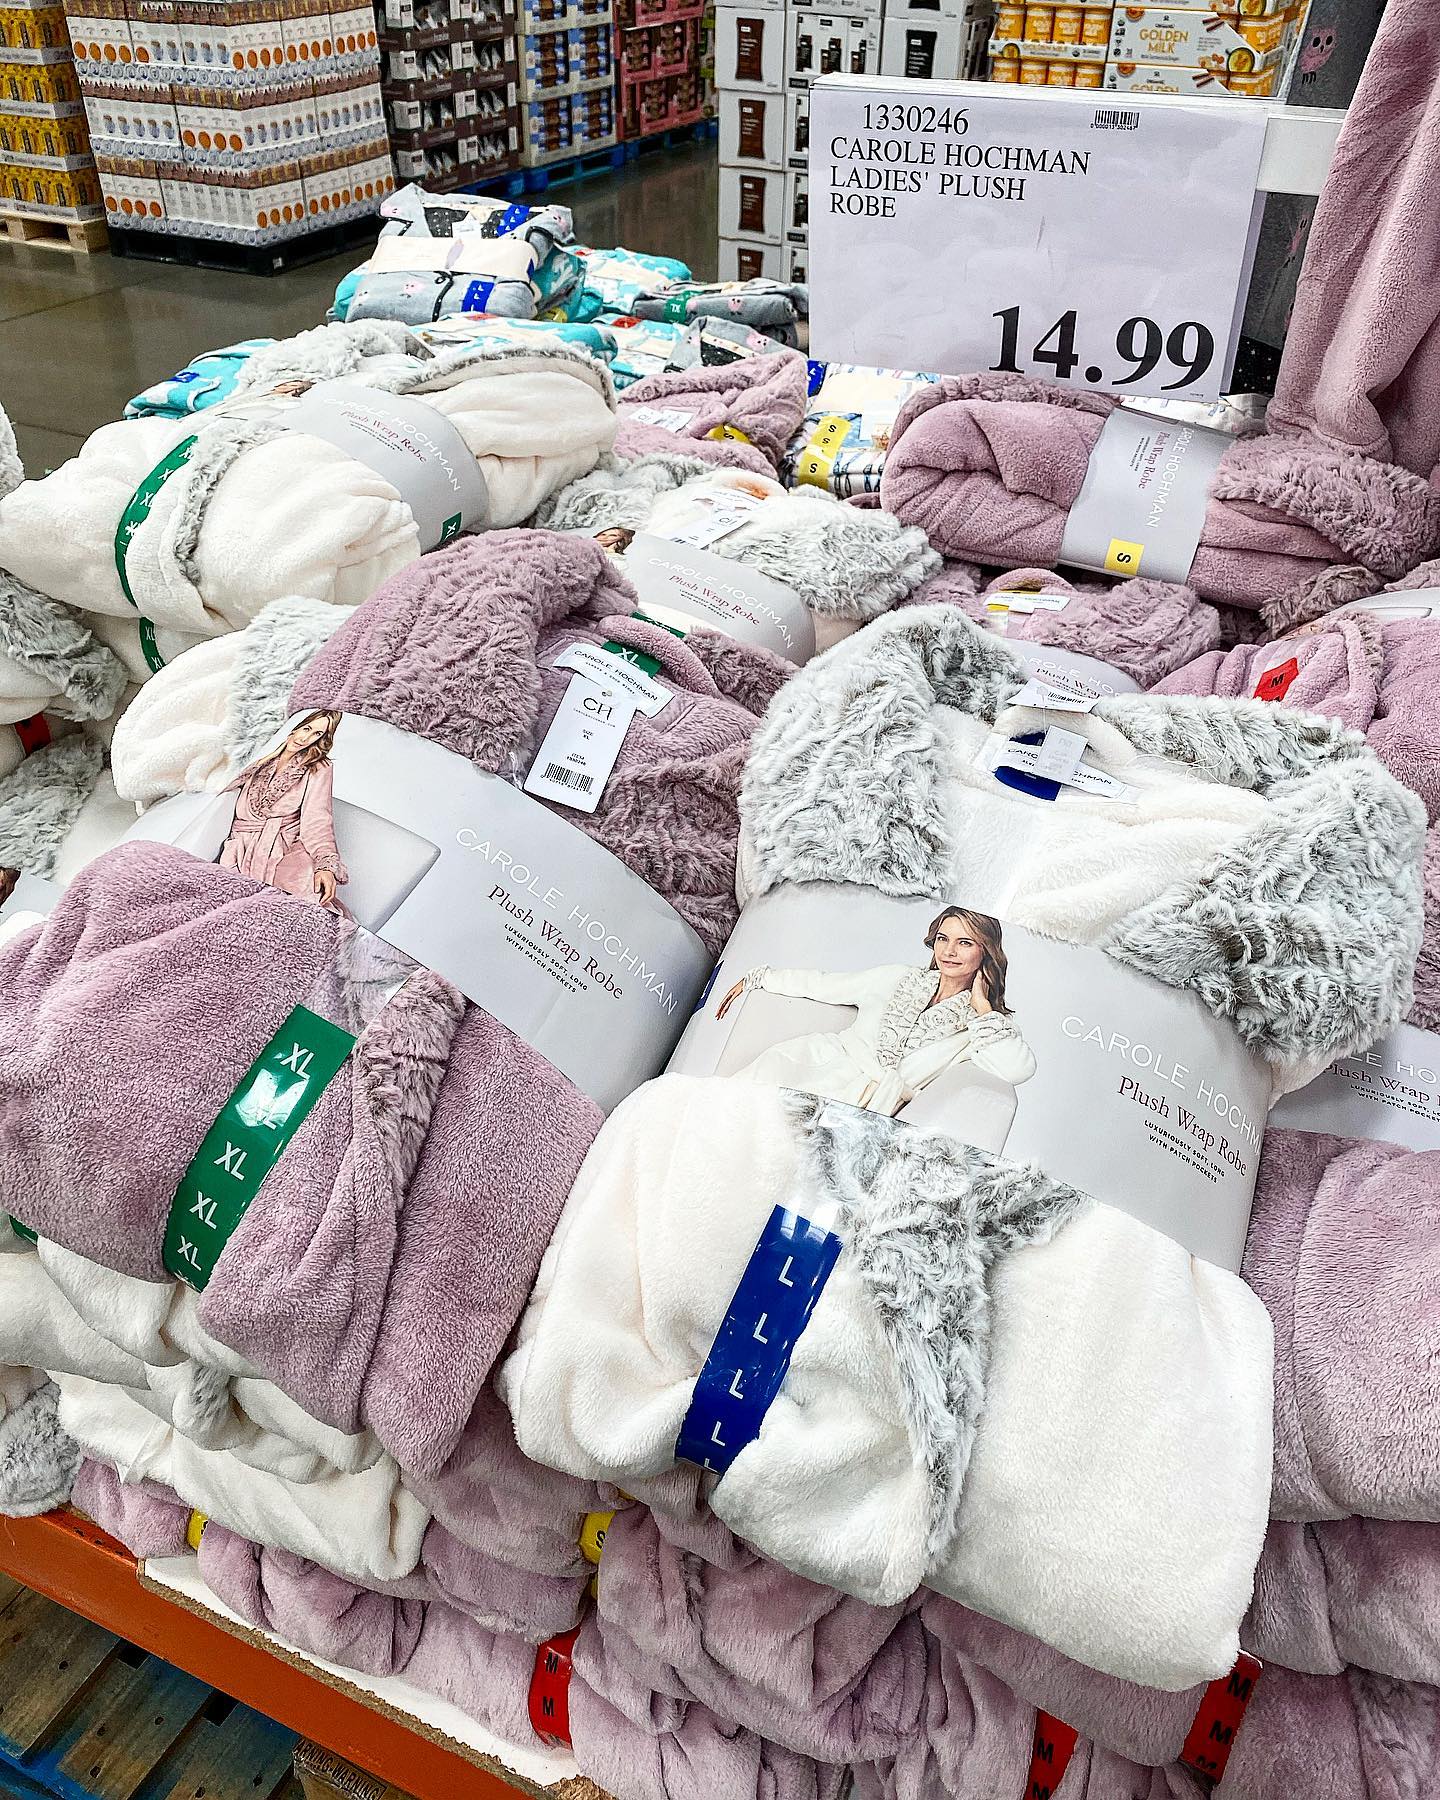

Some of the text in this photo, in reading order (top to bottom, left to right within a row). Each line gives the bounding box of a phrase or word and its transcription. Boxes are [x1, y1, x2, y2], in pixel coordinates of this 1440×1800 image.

[1140, 28, 1188, 42] GOLDEN
[1147, 41, 1175, 53] MILK
[863, 103, 969, 135] 1330246
[830, 137, 1091, 175] CAROLE HOCHMAN
[830, 166, 1027, 201] LADIES' PLUSH
[829, 193, 897, 218] ROBE
[988, 305, 1215, 391] 14.99
[373, 420, 399, 440] Wrap
[400, 438, 427, 463] Robe
[828, 424, 837, 433] S
[392, 415, 461, 491] HOCHMAN
[810, 463, 818, 474] S
[1145, 447, 1164, 465] Wrap
[1139, 467, 1156, 489] Robe
[1145, 454, 1182, 528] HOCHMAN
[1116, 552, 1131, 564] S
[647, 557, 794, 649] CAROLE HOCHMAN
[668, 574, 760, 626] Plush Wrap Robe
[614, 647, 640, 669] XL
[574, 650, 613, 669] CAROLE
[614, 669, 658, 701] HOCHMAN
[1270, 672, 1285, 689] M
[583, 697, 613, 721] CH
[1008, 748, 1039, 759] CARO
[1073, 770, 1112, 785] CHMAN
[455, 827, 678, 1016] CAROLE HOCHMAN
[487, 884, 623, 1000] Plush Wrap Robe
[504, 923, 588, 991] LUXURIOUSLY SOFT, LONG
[506, 935, 577, 993] WITH PATCH POCKETS
[280, 1042, 315, 1080] XL
[1060, 1014, 1191, 1091] CAROLE
[1350, 1084, 1404, 1103] LUXURIOUSLY
[1380, 1075, 1430, 1104] Wrap
[1358, 1092, 1440, 1122] WITH PATCH POCKET
[1117, 1075, 1247, 1176] Plush Wrap Robe
[213, 1141, 246, 1181] XL
[1144, 1119, 1225, 1177] LUXURIOUSLY SOFT, LONG
[1149, 1134, 1218, 1183] WITH PATCH POCKETS
[189, 1190, 217, 1230] XL
[177, 1235, 202, 1272] XL
[778, 1255, 794, 1288] L
[752, 1312, 768, 1345] L
[728, 1368, 744, 1400] L
[710, 1421, 726, 1447] L
[545, 1651, 559, 1675] M
[1227, 1672, 1252, 1701] M
[542, 1696, 554, 1718] M
[1209, 1720, 1233, 1746] M
[1037, 1738, 1054, 1765] M
